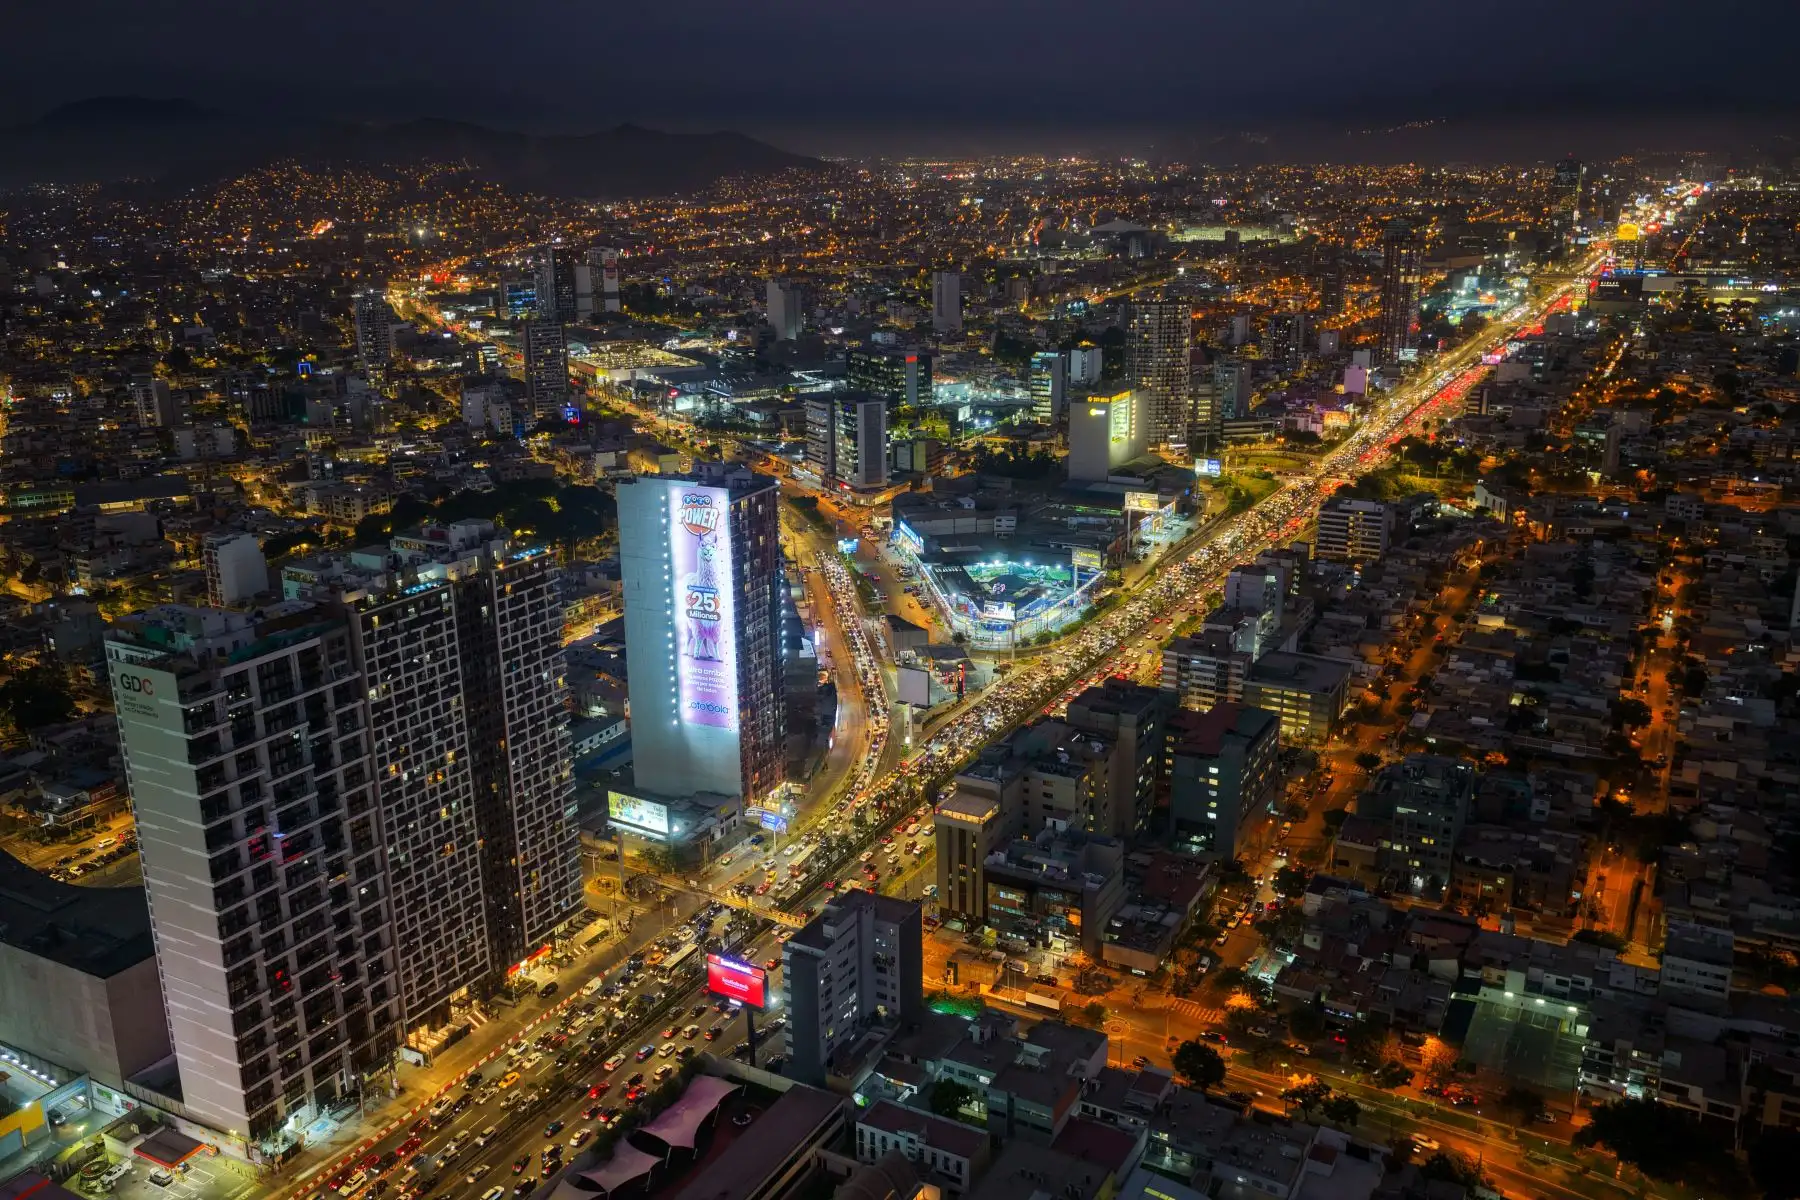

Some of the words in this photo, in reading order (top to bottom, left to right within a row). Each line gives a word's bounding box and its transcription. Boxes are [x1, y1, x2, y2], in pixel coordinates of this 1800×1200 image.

[677, 507, 719, 531] POWER
[691, 590, 716, 613] 25
[689, 610, 718, 621] Millones
[120, 673, 154, 696] GDC
